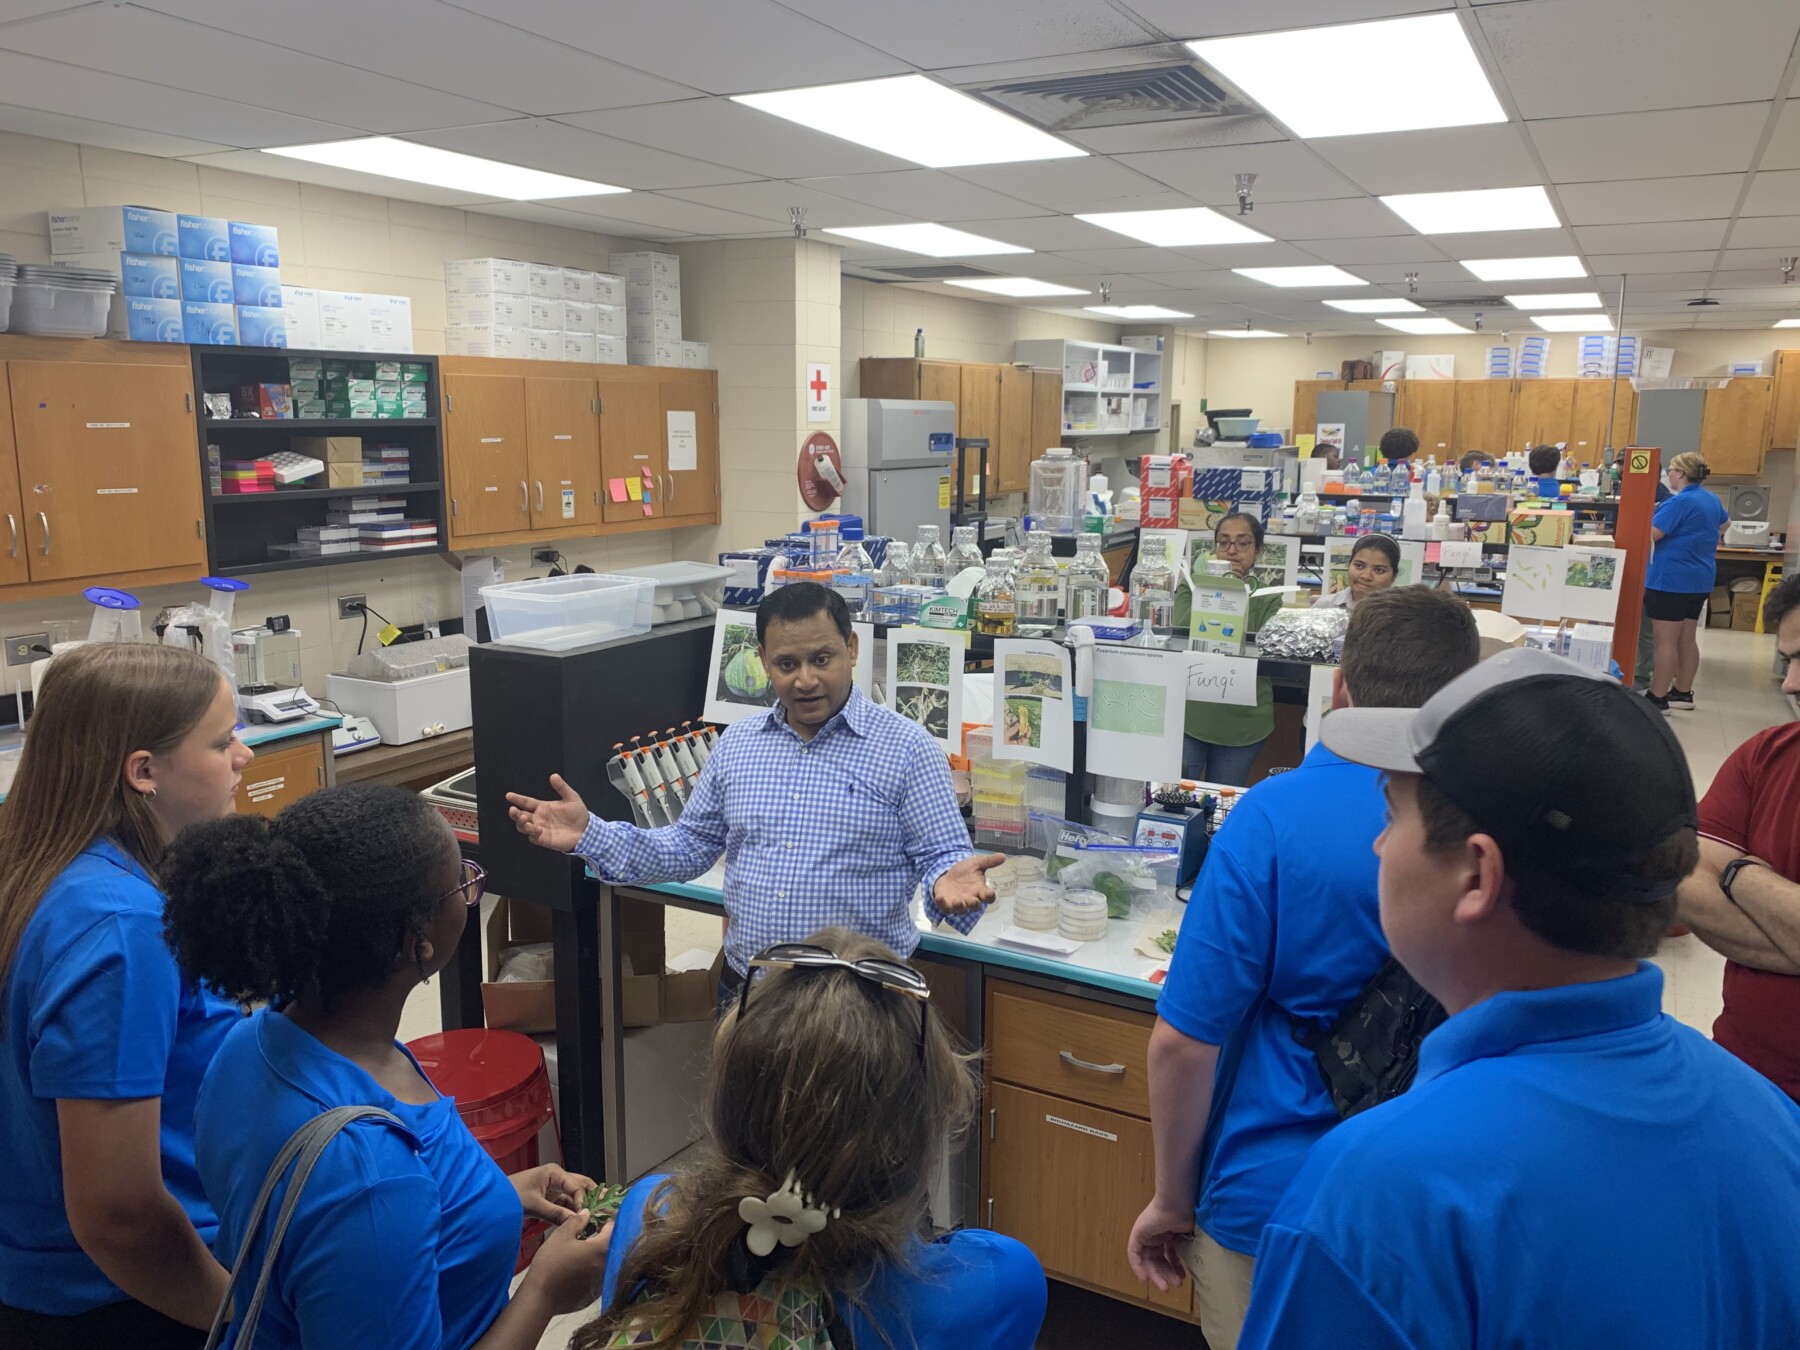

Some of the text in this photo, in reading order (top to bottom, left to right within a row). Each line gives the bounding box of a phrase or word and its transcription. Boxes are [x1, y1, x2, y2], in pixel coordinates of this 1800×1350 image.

[1443, 544, 1471, 565] Fungi
[929, 606, 958, 614] KIMTECH
[1186, 662, 1236, 699] Fungi
[1050, 1117, 1109, 1138] BIOHAZARD BAGS
